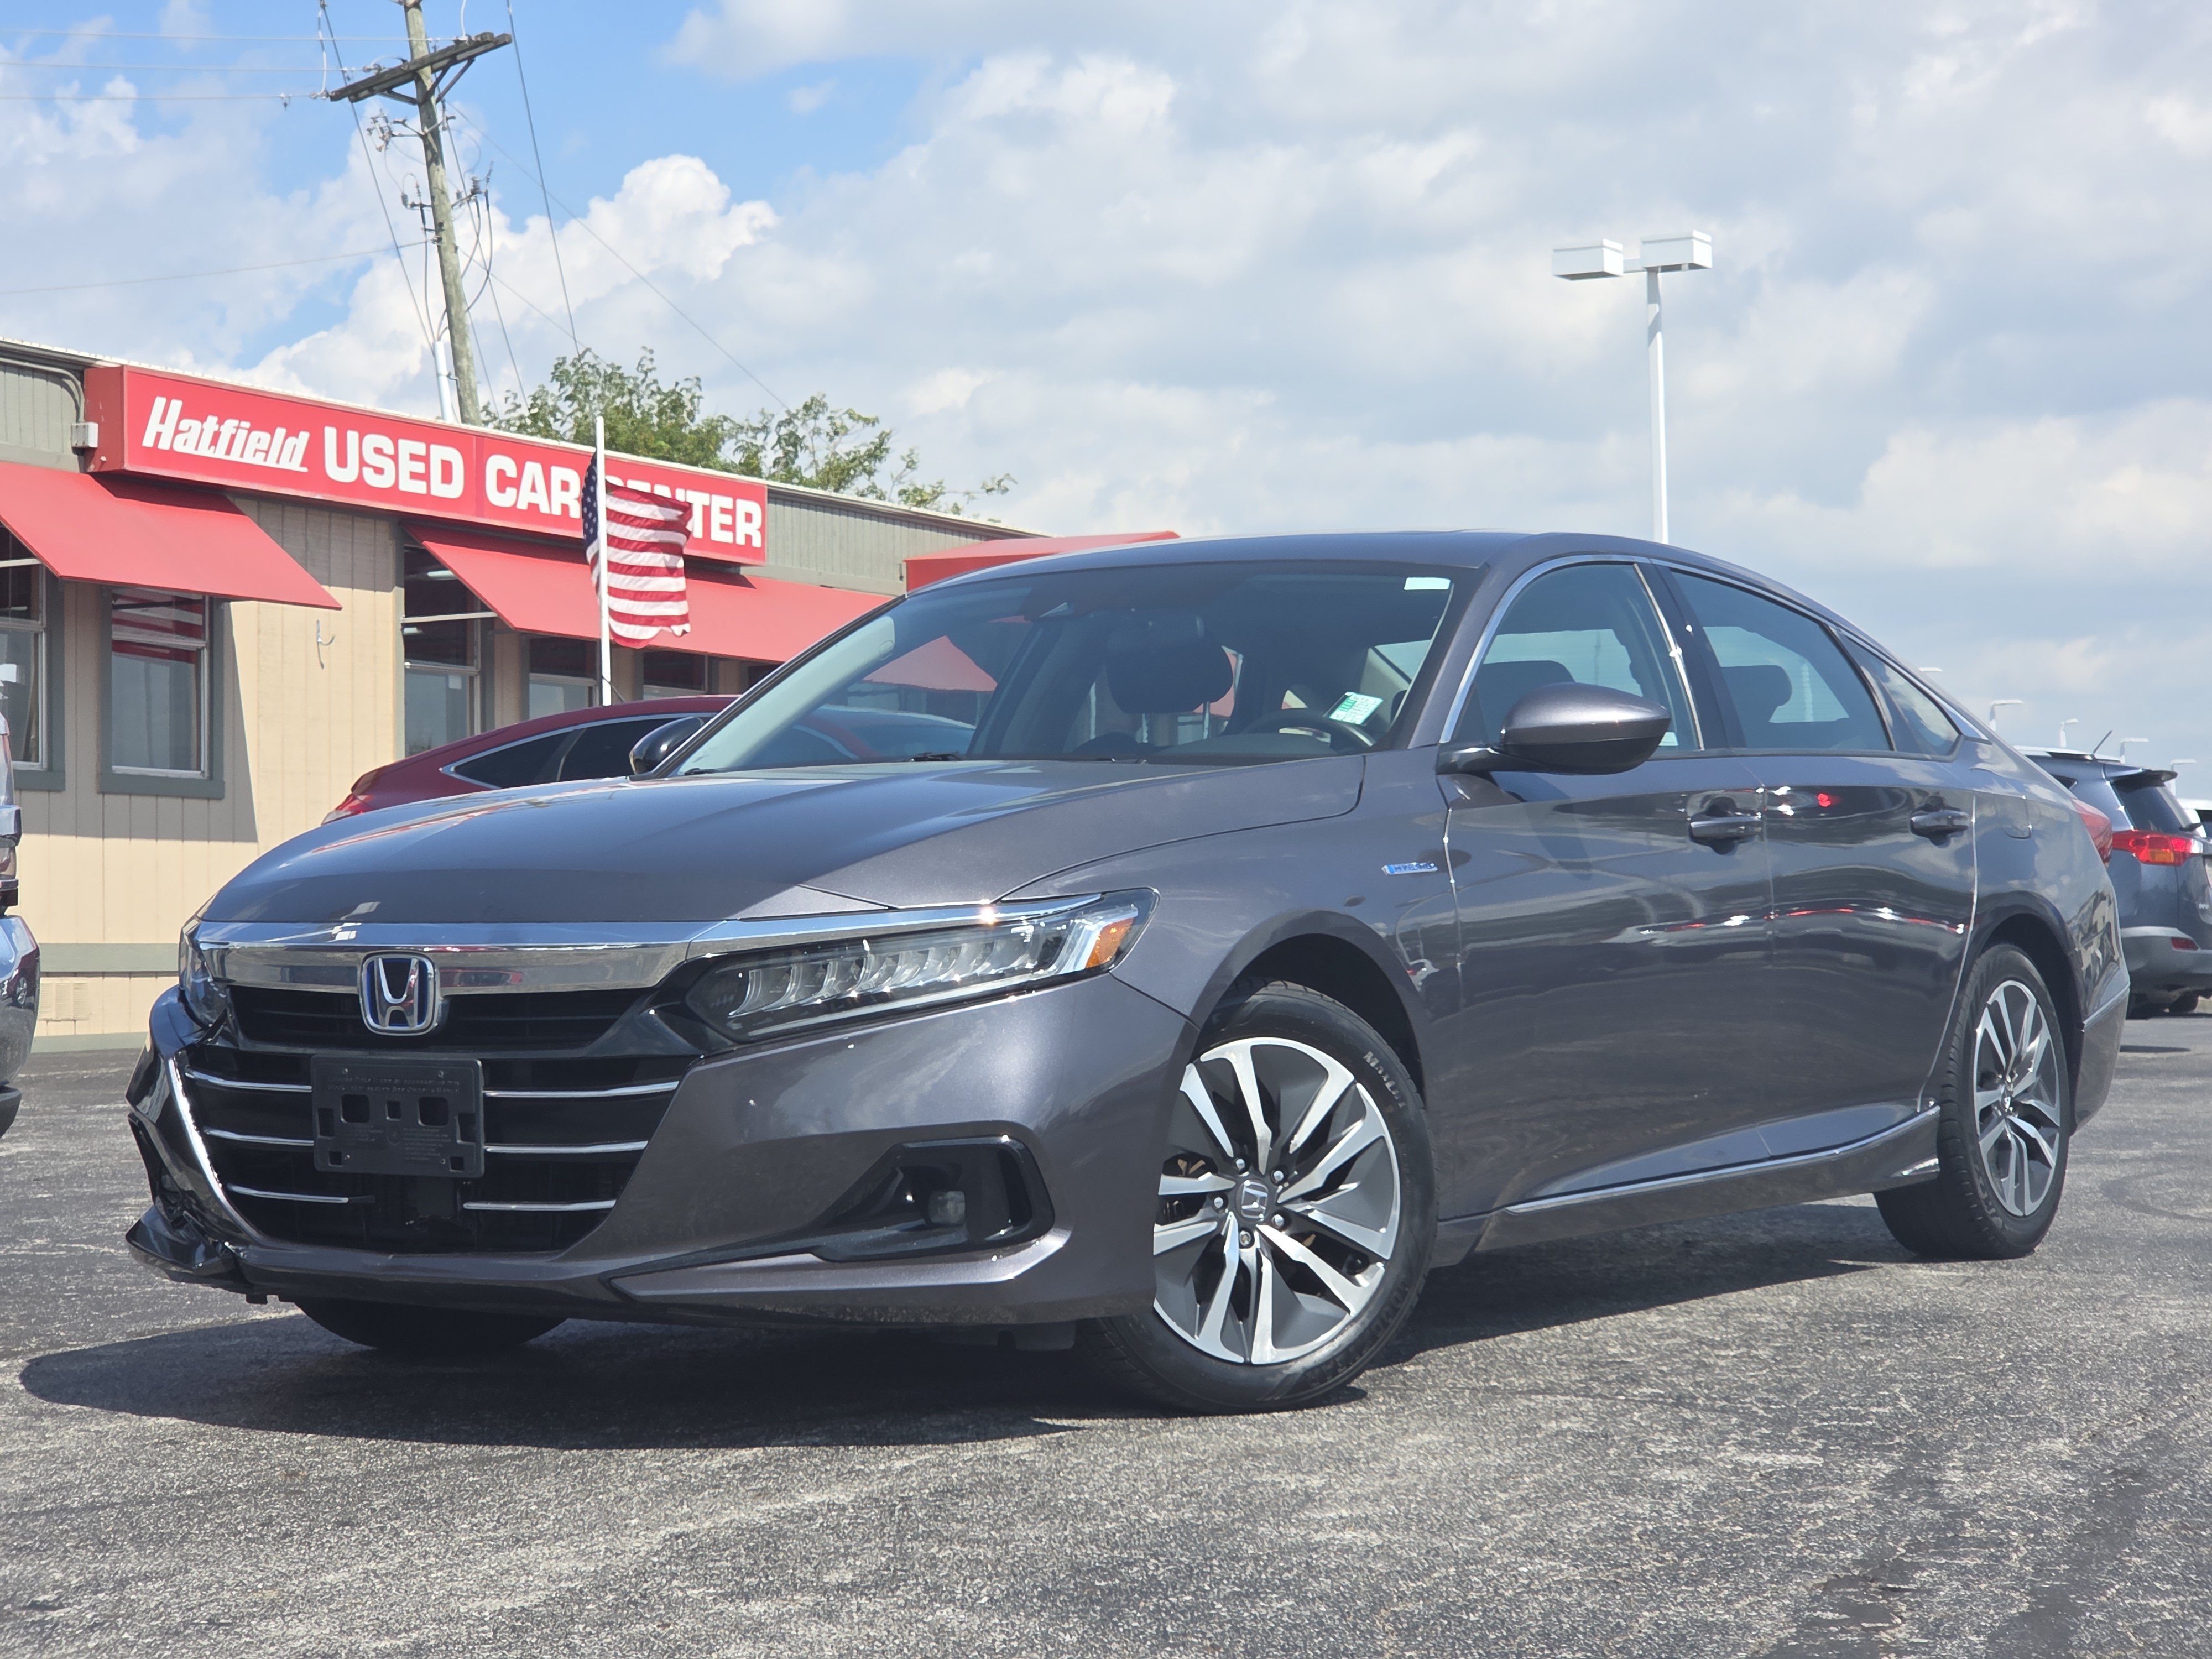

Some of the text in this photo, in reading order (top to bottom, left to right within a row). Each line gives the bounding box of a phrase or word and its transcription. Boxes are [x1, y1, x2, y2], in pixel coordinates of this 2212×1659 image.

[142, 395, 310, 473] Hatfield
[324, 425, 465, 499] USED
[485, 453, 581, 519] CAR
